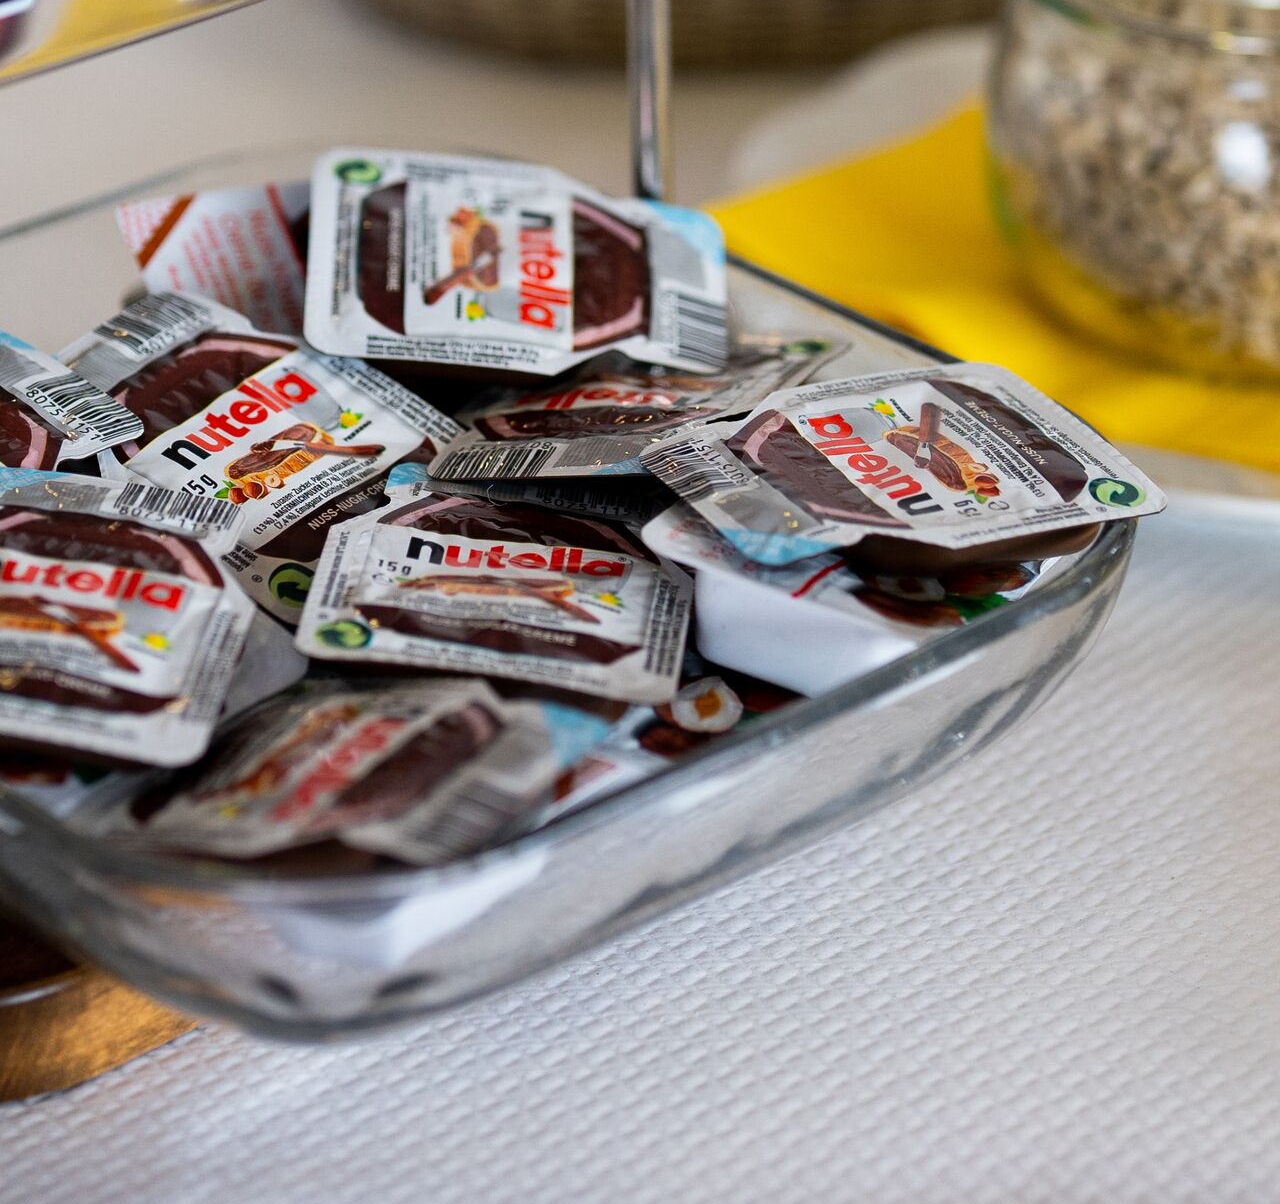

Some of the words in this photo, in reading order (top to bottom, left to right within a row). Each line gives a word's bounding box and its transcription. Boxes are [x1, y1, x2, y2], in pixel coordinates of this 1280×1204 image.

[516, 209, 558, 331] nutella
[160, 370, 317, 470] nutella
[804, 413, 943, 517] nutella
[307, 478, 385, 530] NUSS-NUGAT-CRE
[406, 536, 626, 579] nutella
